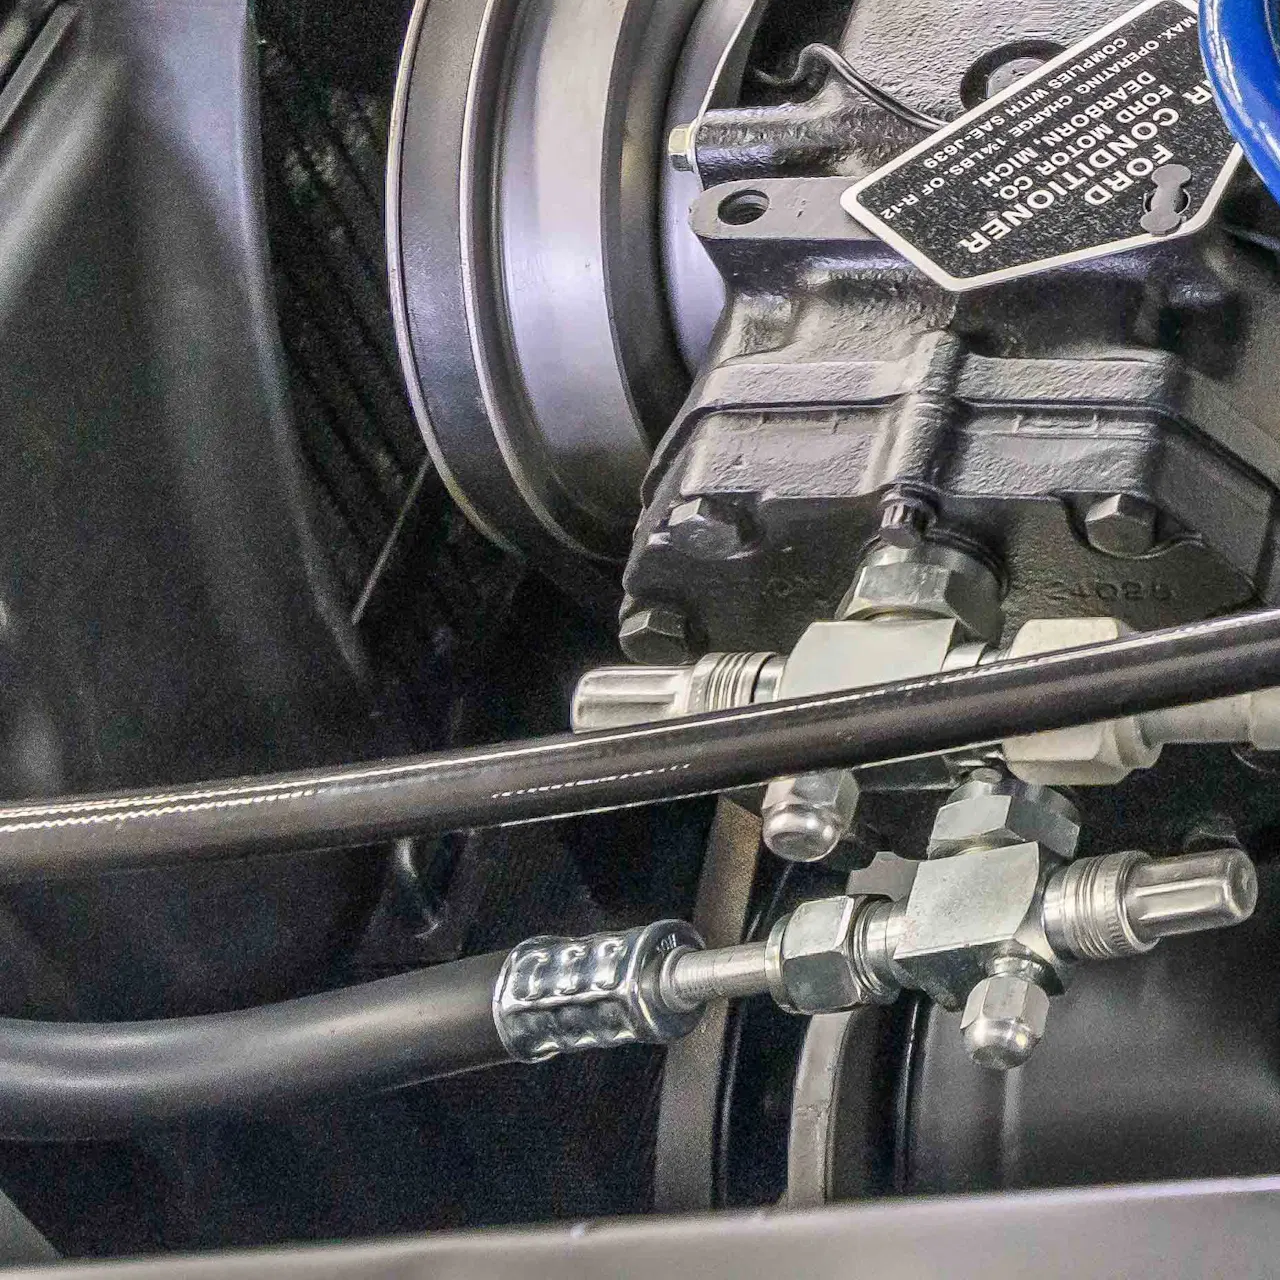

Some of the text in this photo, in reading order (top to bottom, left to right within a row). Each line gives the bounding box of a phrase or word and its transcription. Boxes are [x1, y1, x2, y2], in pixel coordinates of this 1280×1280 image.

[1157, 15, 1197, 40] MAX.
[1074, 40, 1161, 95] OPERATING
[924, 36, 1129, 169] COMPLIES WITH SAE-J639
[972, 70, 1157, 191] DEARBORN, MICH.
[1013, 95, 1073, 138] CHARGE
[993, 83, 1175, 201] FORD MOTOR CO.
[920, 175, 947, 197] OF
[959, 107, 1180, 255] CONDITIONER
[1084, 143, 1175, 207] FORD
[882, 193, 920, 220] R-12
